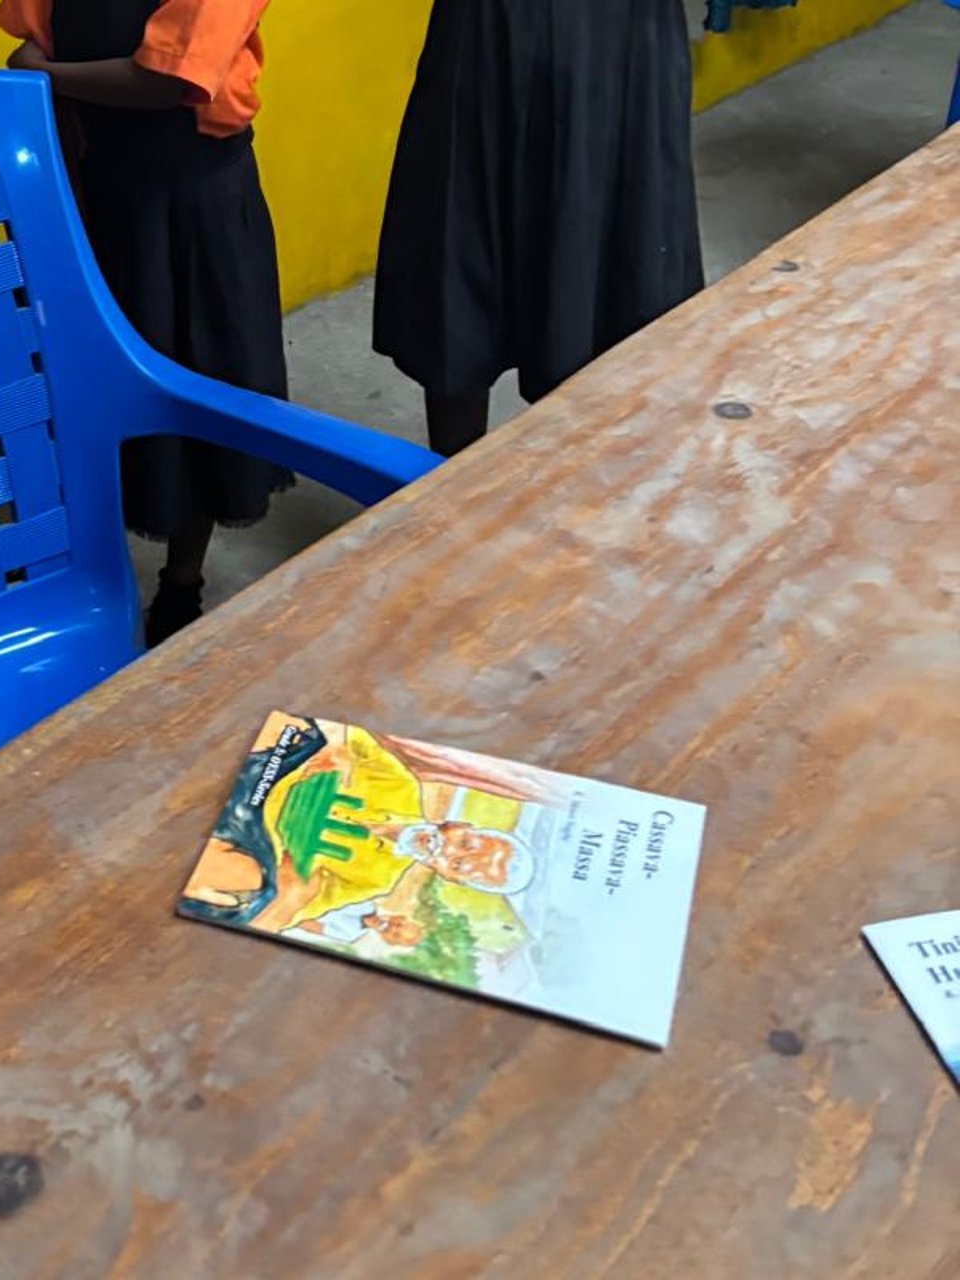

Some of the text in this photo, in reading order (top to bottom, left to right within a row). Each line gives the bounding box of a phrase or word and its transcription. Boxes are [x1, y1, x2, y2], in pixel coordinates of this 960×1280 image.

[572, 828, 603, 881] Massa
[605, 819, 639, 895] Piassava-
[642, 810, 675, 880] Cassava-
